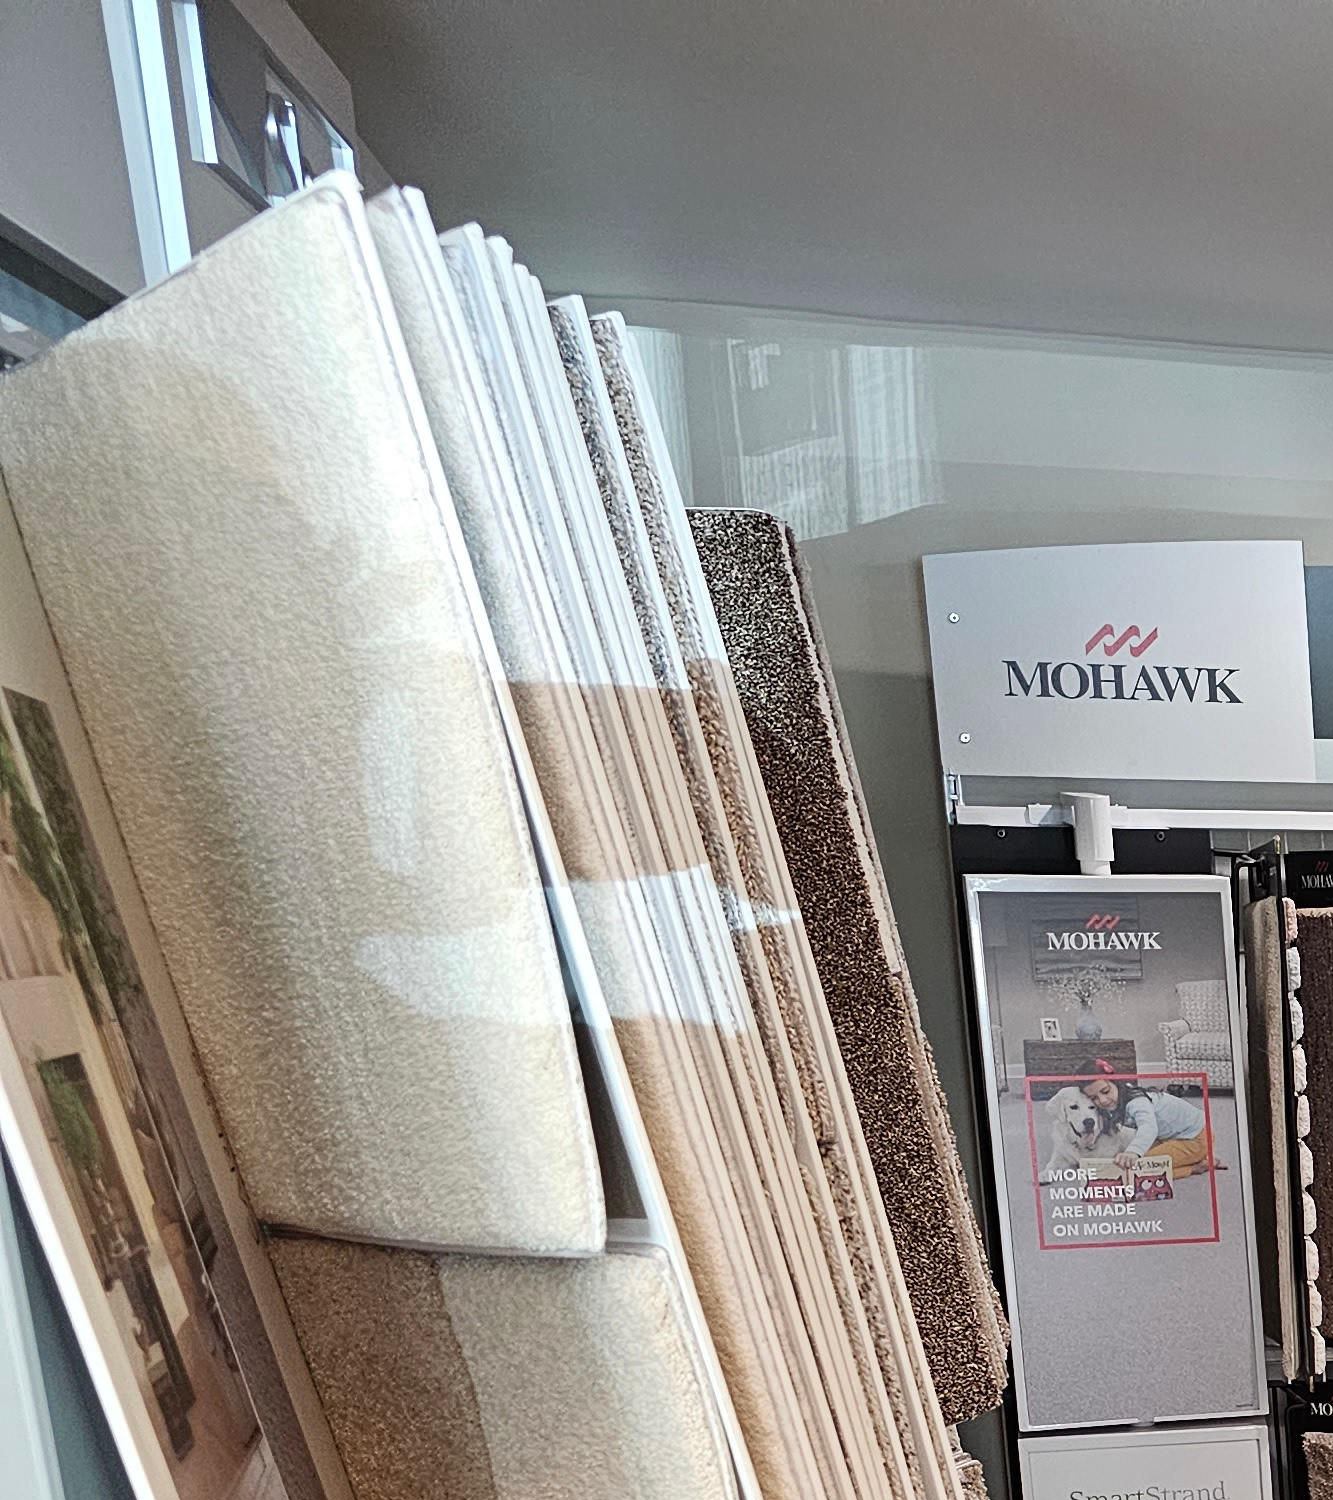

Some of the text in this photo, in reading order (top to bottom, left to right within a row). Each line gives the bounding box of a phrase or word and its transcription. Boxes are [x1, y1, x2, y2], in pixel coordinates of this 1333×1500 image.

[1001, 660, 1244, 704] MOHAWK
[1046, 931, 1163, 952] MOHAWK
[1048, 1168, 1098, 1182] MORE
[1049, 1185, 1135, 1200] MOMENTS
[1052, 1203, 1137, 1219] ARE MADE
[1053, 1220, 1164, 1237] ON MOHAWK
